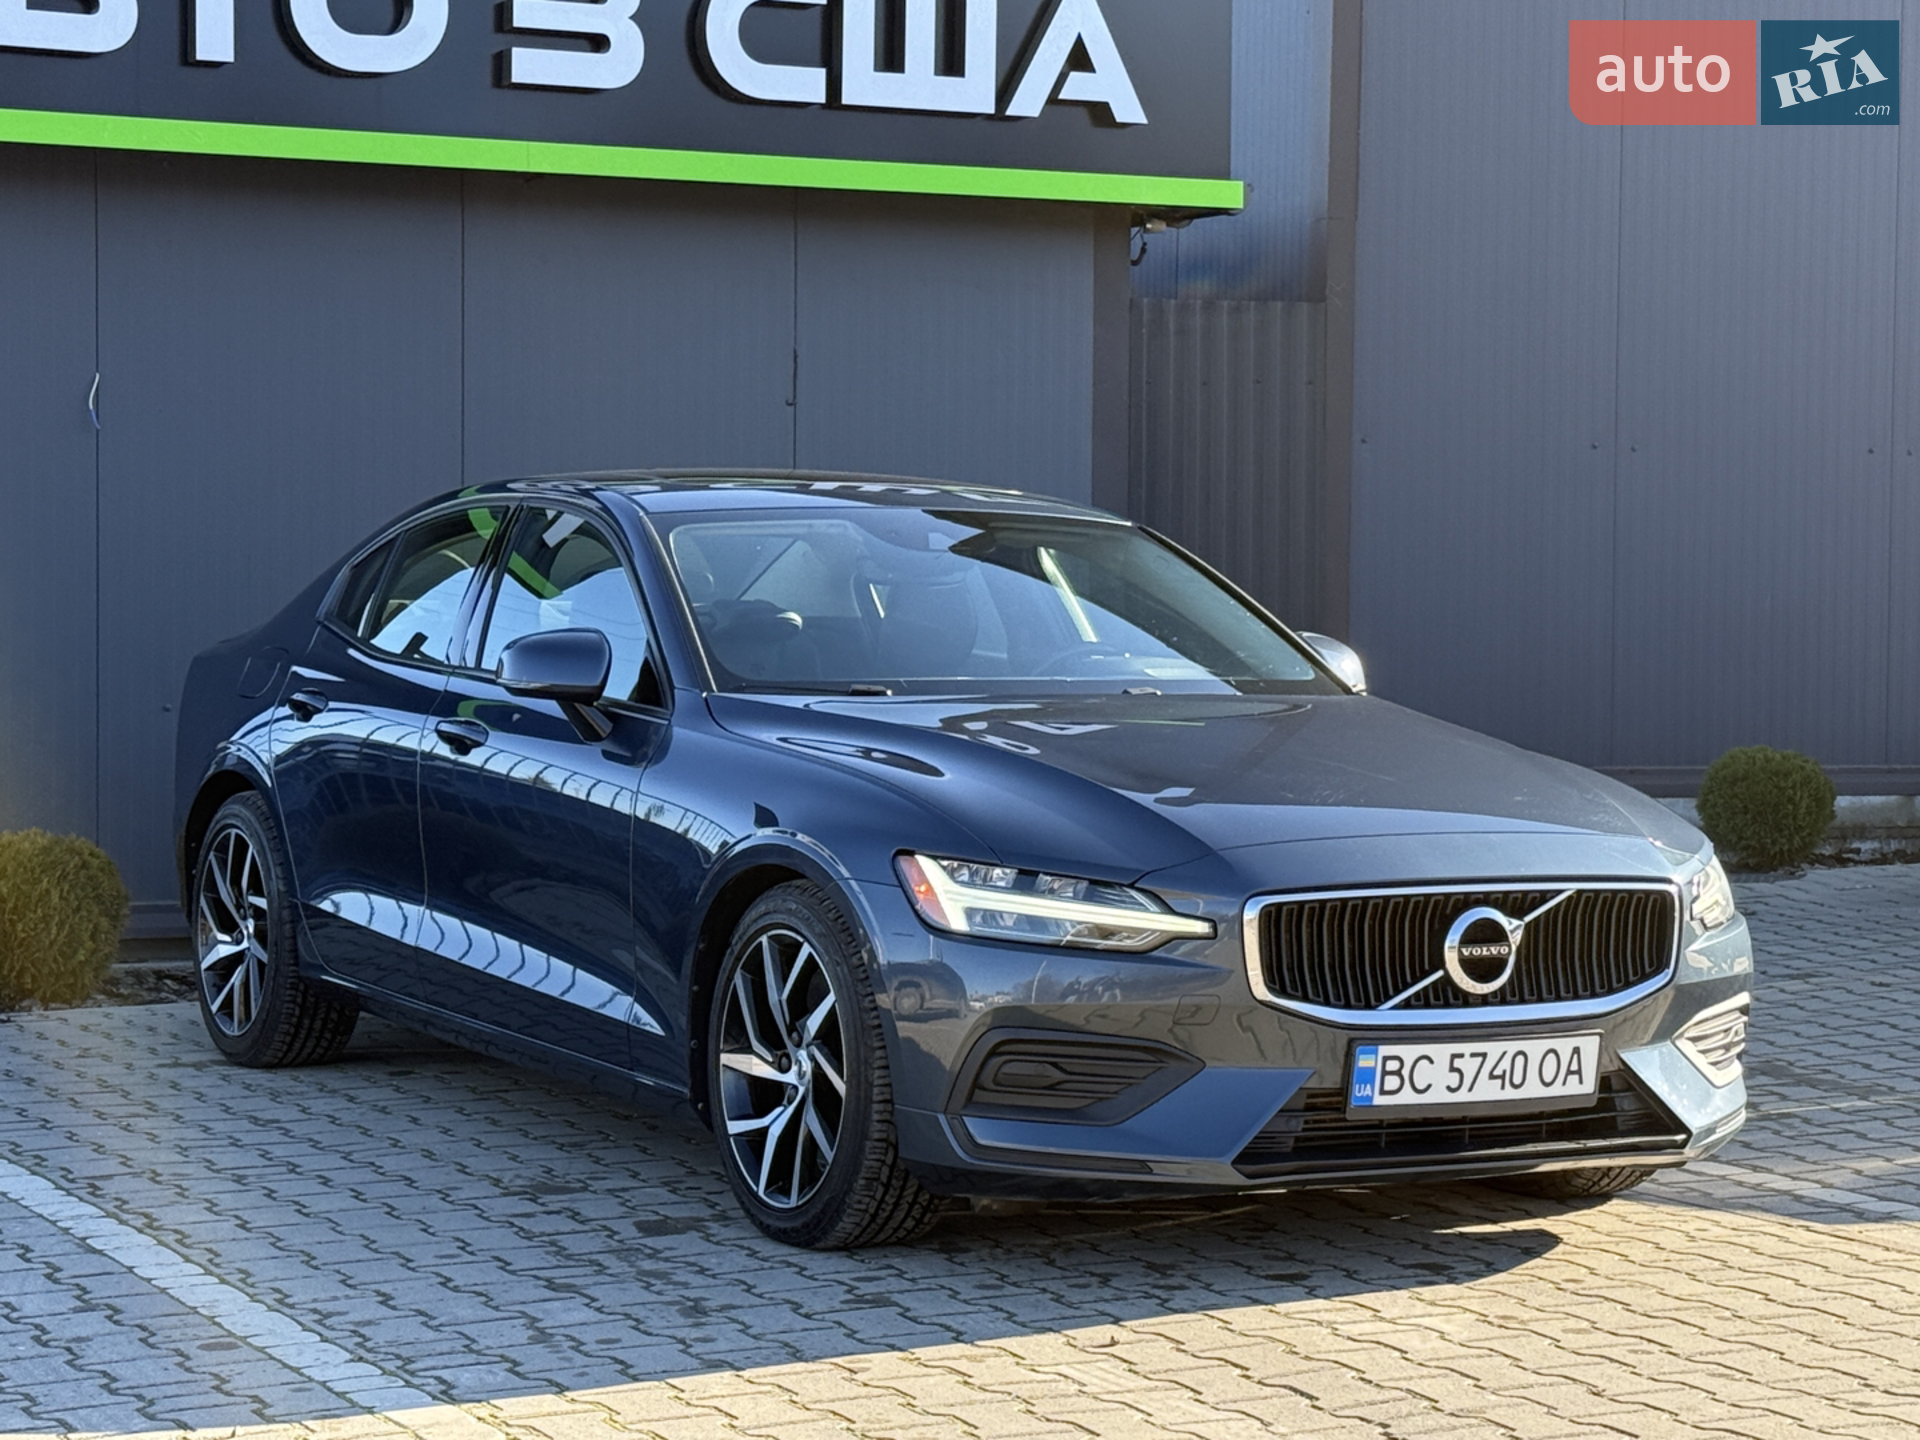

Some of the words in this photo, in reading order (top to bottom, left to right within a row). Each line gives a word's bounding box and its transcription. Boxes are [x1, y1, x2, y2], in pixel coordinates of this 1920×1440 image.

[706, 0, 1149, 125] США
[1460, 945, 1509, 957] VOLVO
[1379, 1054, 1435, 1096] BC
[1445, 1050, 1529, 1094] 5740
[1538, 1046, 1584, 1088] OA
[1355, 1084, 1373, 1097] UA
